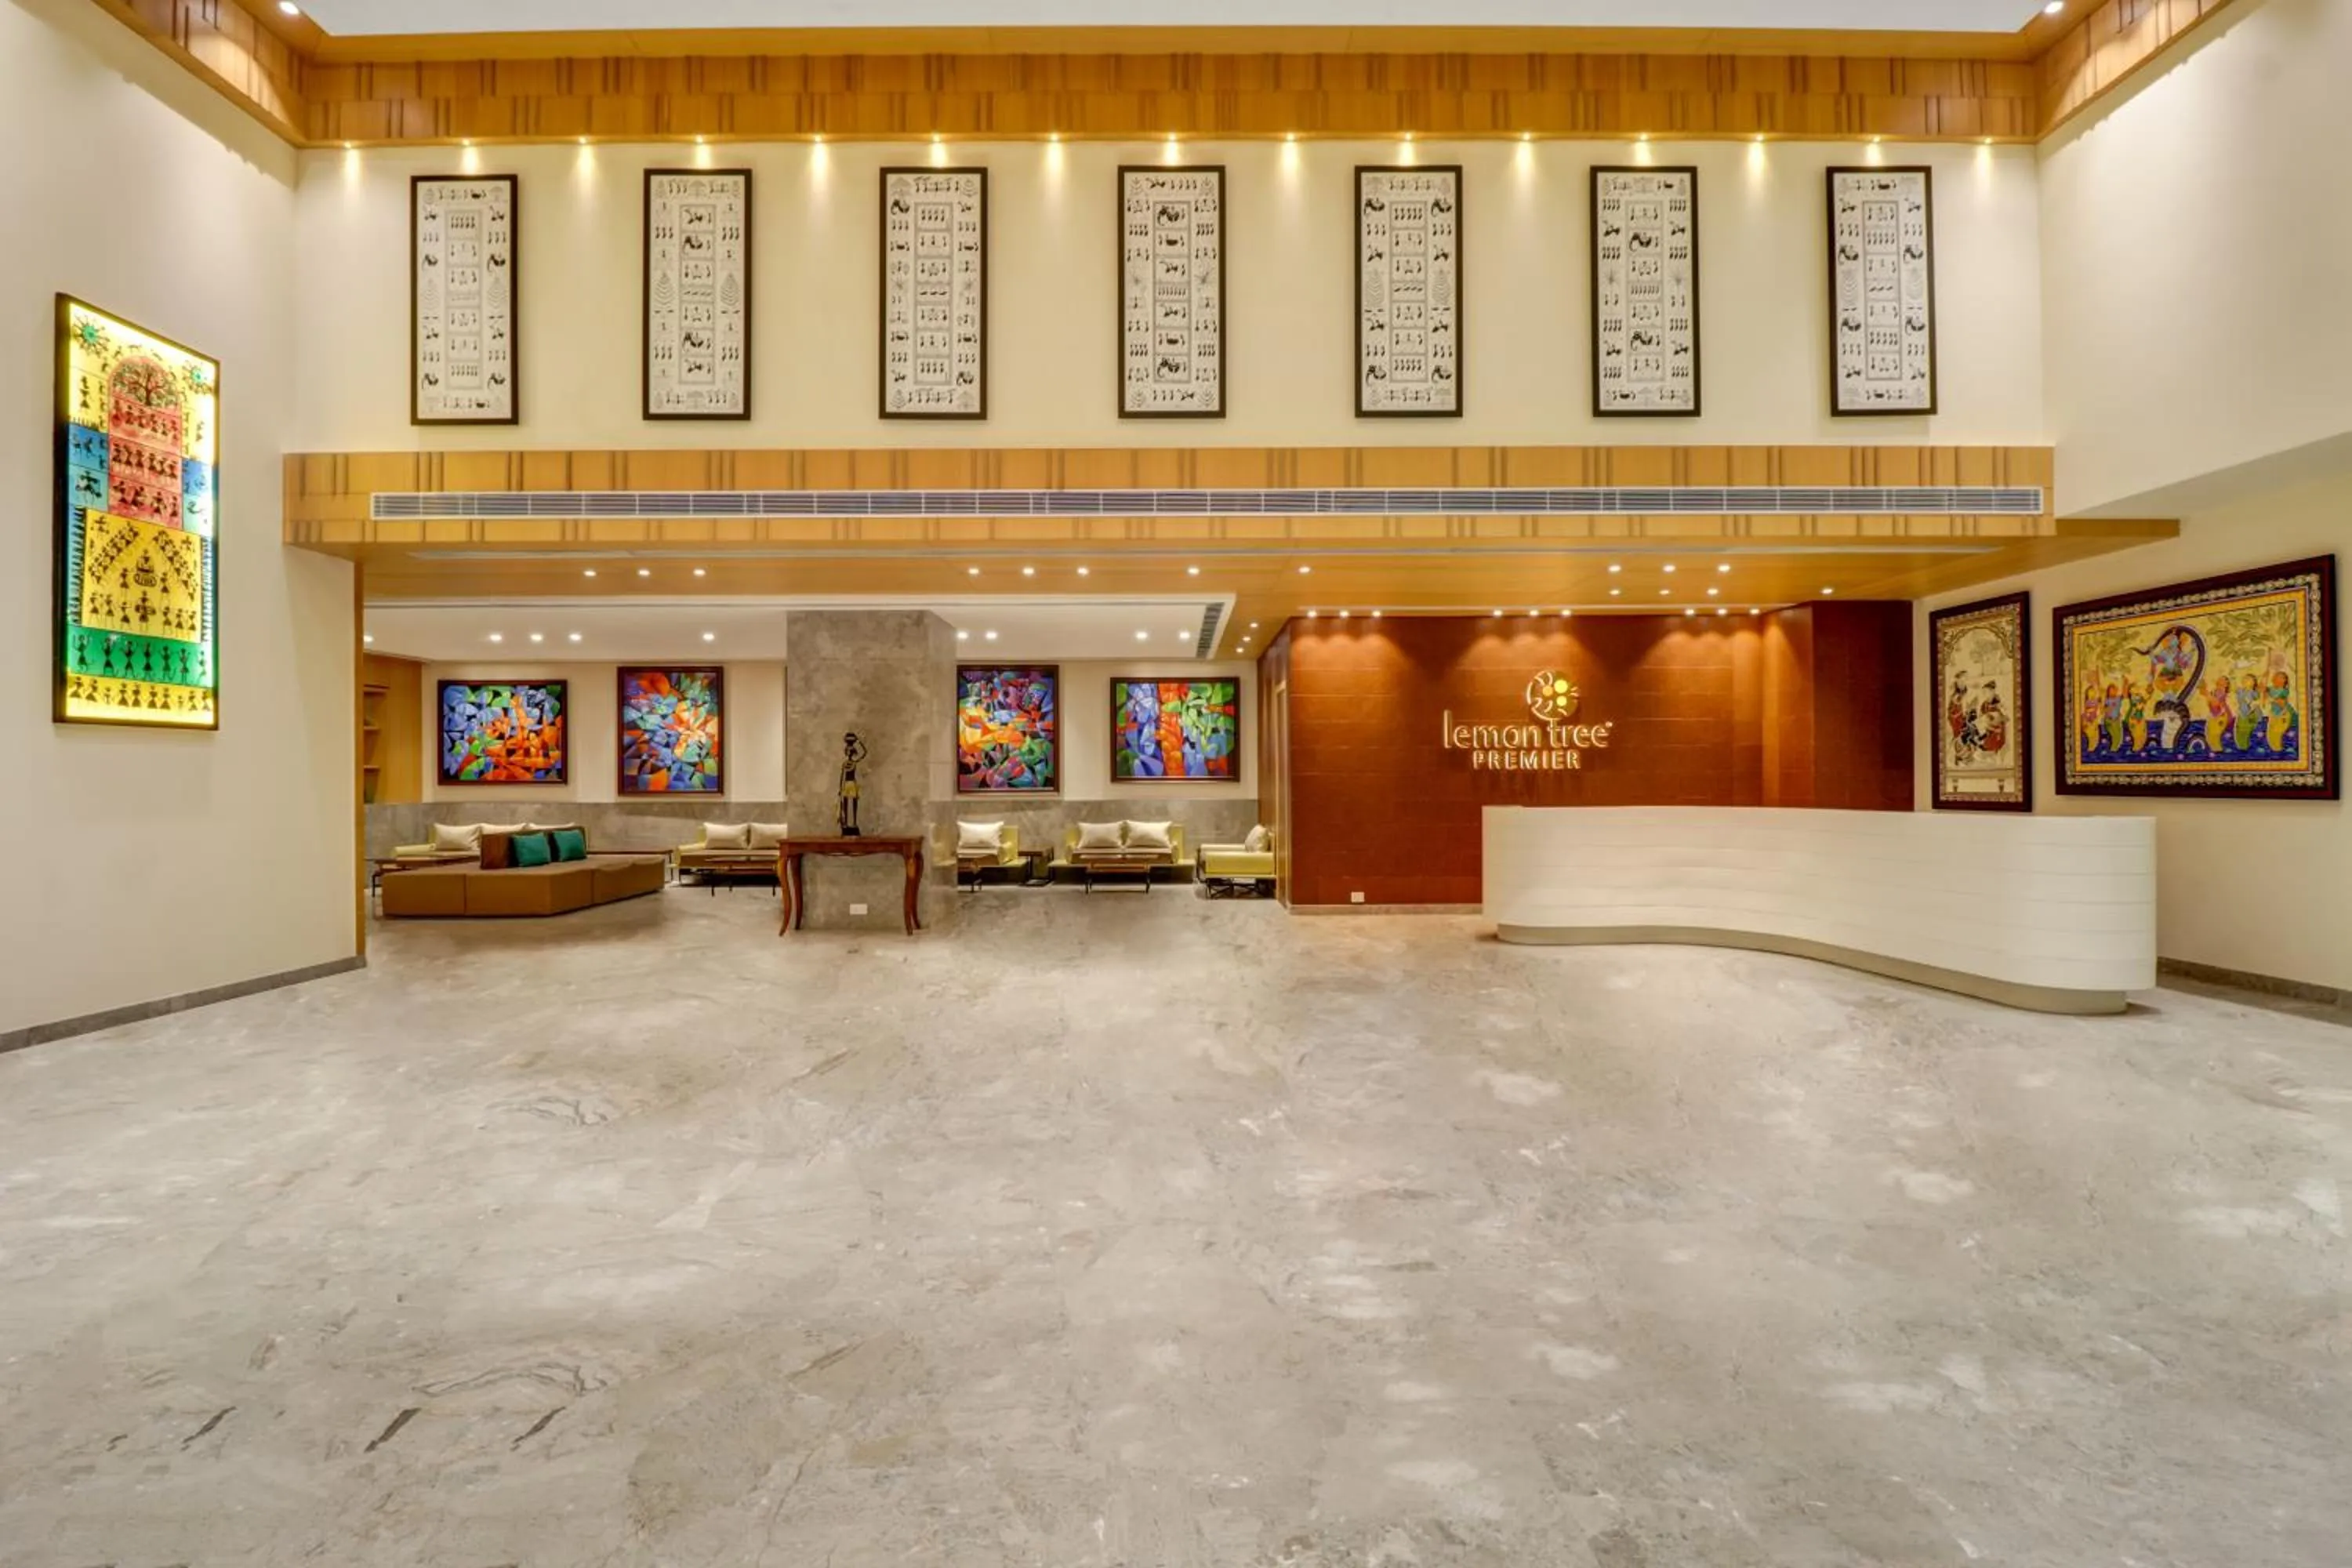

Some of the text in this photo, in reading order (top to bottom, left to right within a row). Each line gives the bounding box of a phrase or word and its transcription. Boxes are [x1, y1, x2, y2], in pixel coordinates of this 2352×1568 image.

[1443, 710, 1610, 749] lemon tree
[1472, 750, 1581, 770] PREMIER
